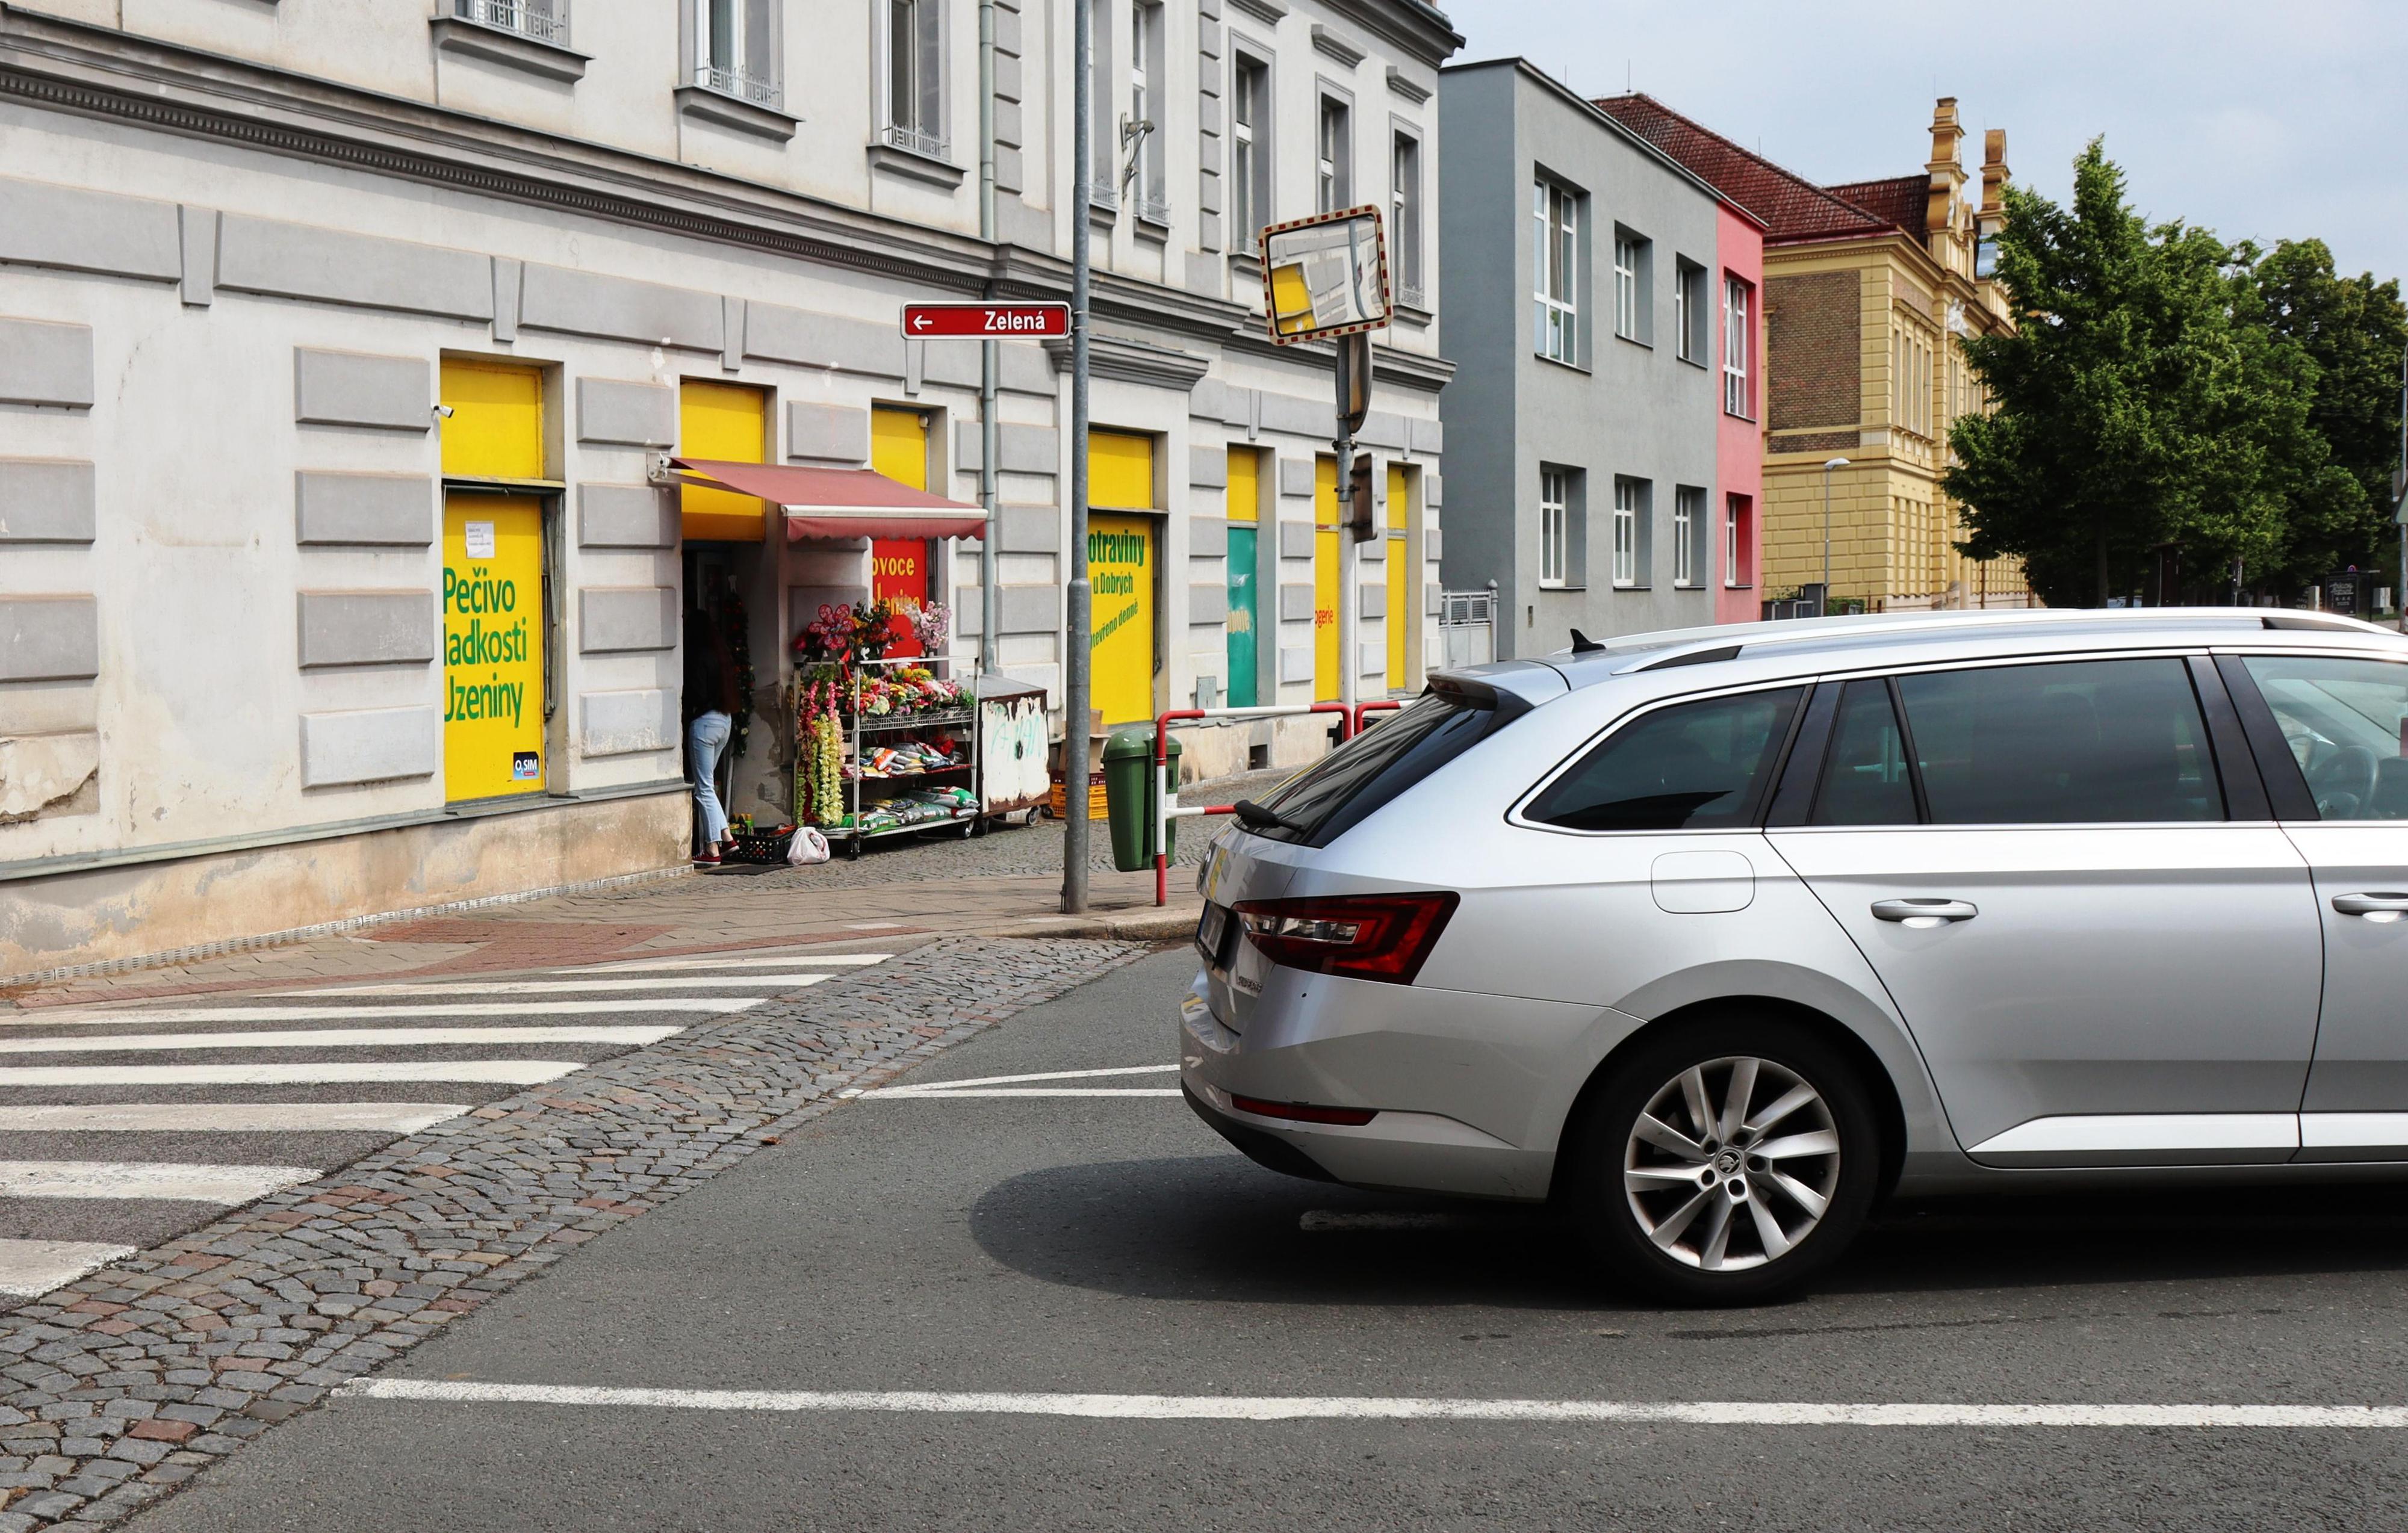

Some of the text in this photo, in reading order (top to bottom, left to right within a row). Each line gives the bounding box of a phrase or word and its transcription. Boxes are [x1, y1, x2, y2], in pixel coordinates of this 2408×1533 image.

[984, 310, 1045, 330] Zelená
[1088, 529, 1145, 567] otraviny
[443, 567, 516, 614] Pečivo
[1093, 571, 1134, 596] u Dobrých
[443, 616, 527, 666] ladkosti
[1090, 618, 1118, 651] tevřeno
[523, 758, 538, 770] SIM
